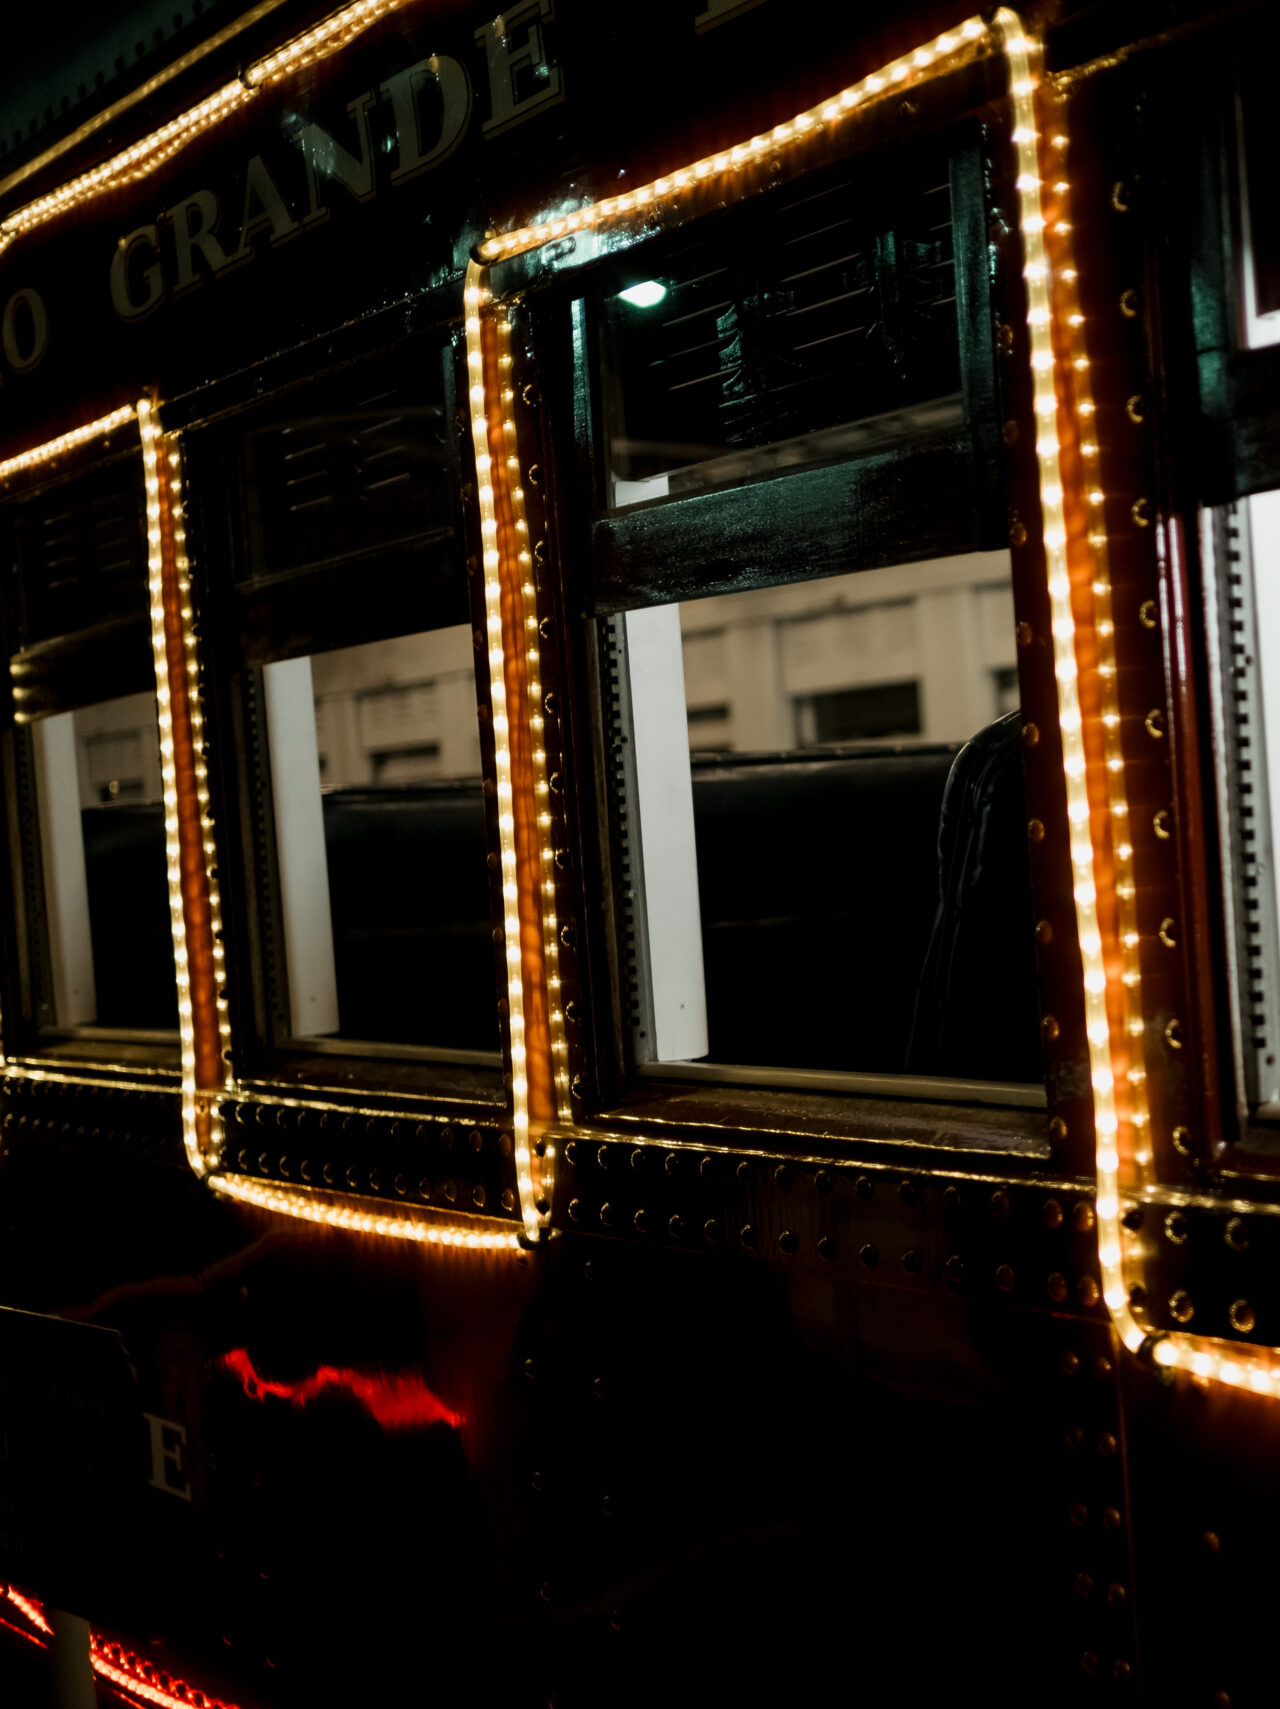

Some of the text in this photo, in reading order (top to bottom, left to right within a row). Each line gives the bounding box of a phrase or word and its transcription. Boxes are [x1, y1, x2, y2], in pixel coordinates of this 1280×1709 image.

[0, 0, 566, 388] O GRANDE
[142, 1411, 193, 1502] E
